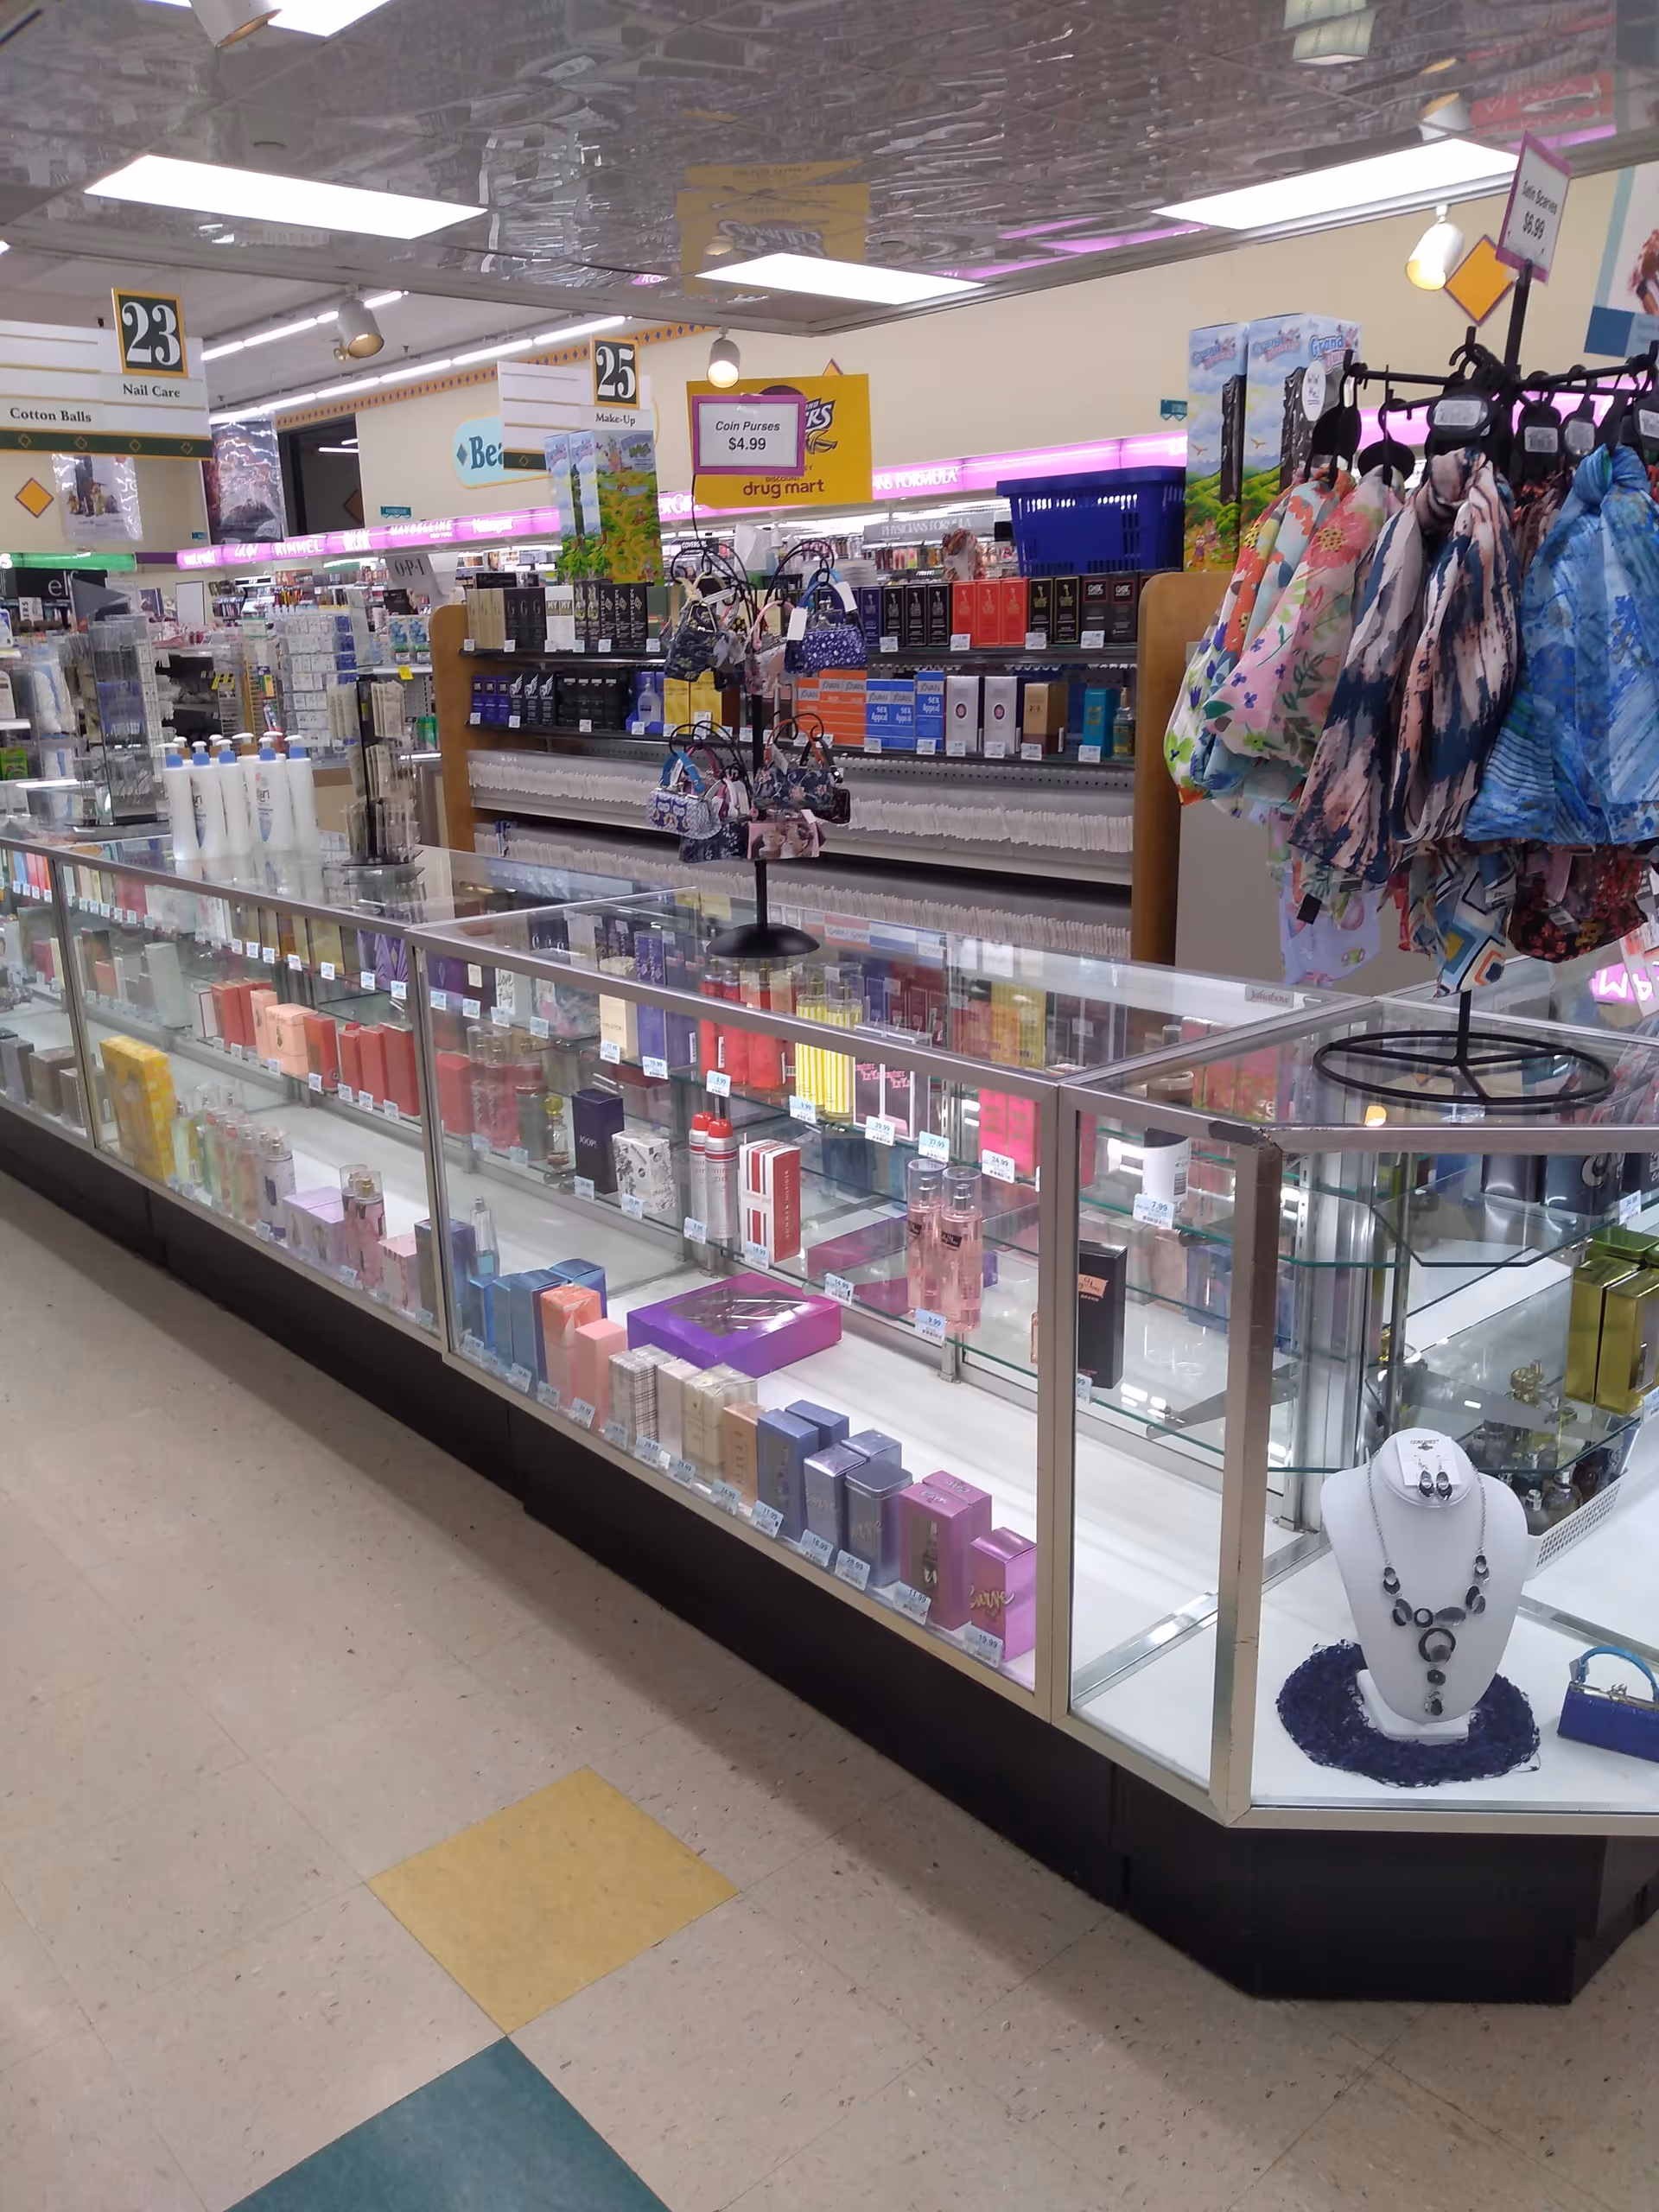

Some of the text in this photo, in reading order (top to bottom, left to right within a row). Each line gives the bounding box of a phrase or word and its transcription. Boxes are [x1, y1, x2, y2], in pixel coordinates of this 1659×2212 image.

[1522, 211, 1545, 240] $6.99
[122, 302, 180, 365] 23
[596, 346, 636, 399] 25
[123, 383, 181, 398] Nail Care
[10, 407, 92, 423] Cotton Balls
[595, 413, 636, 427] Make-Up
[715, 421, 780, 431] Coin Purses
[728, 437, 766, 452] $4.99
[743, 479, 824, 499] drug mart
[274, 539, 324, 556] RIMMEL
[1152, 1201, 1168, 1211] 7.99
[835, 1278, 849, 1289] 14.99
[928, 1316, 941, 1326] 9.99
[764, 1506, 778, 1521] 11.99
[909, 1588, 926, 1603] 11.99
[978, 1633, 998, 1649] 19.99
